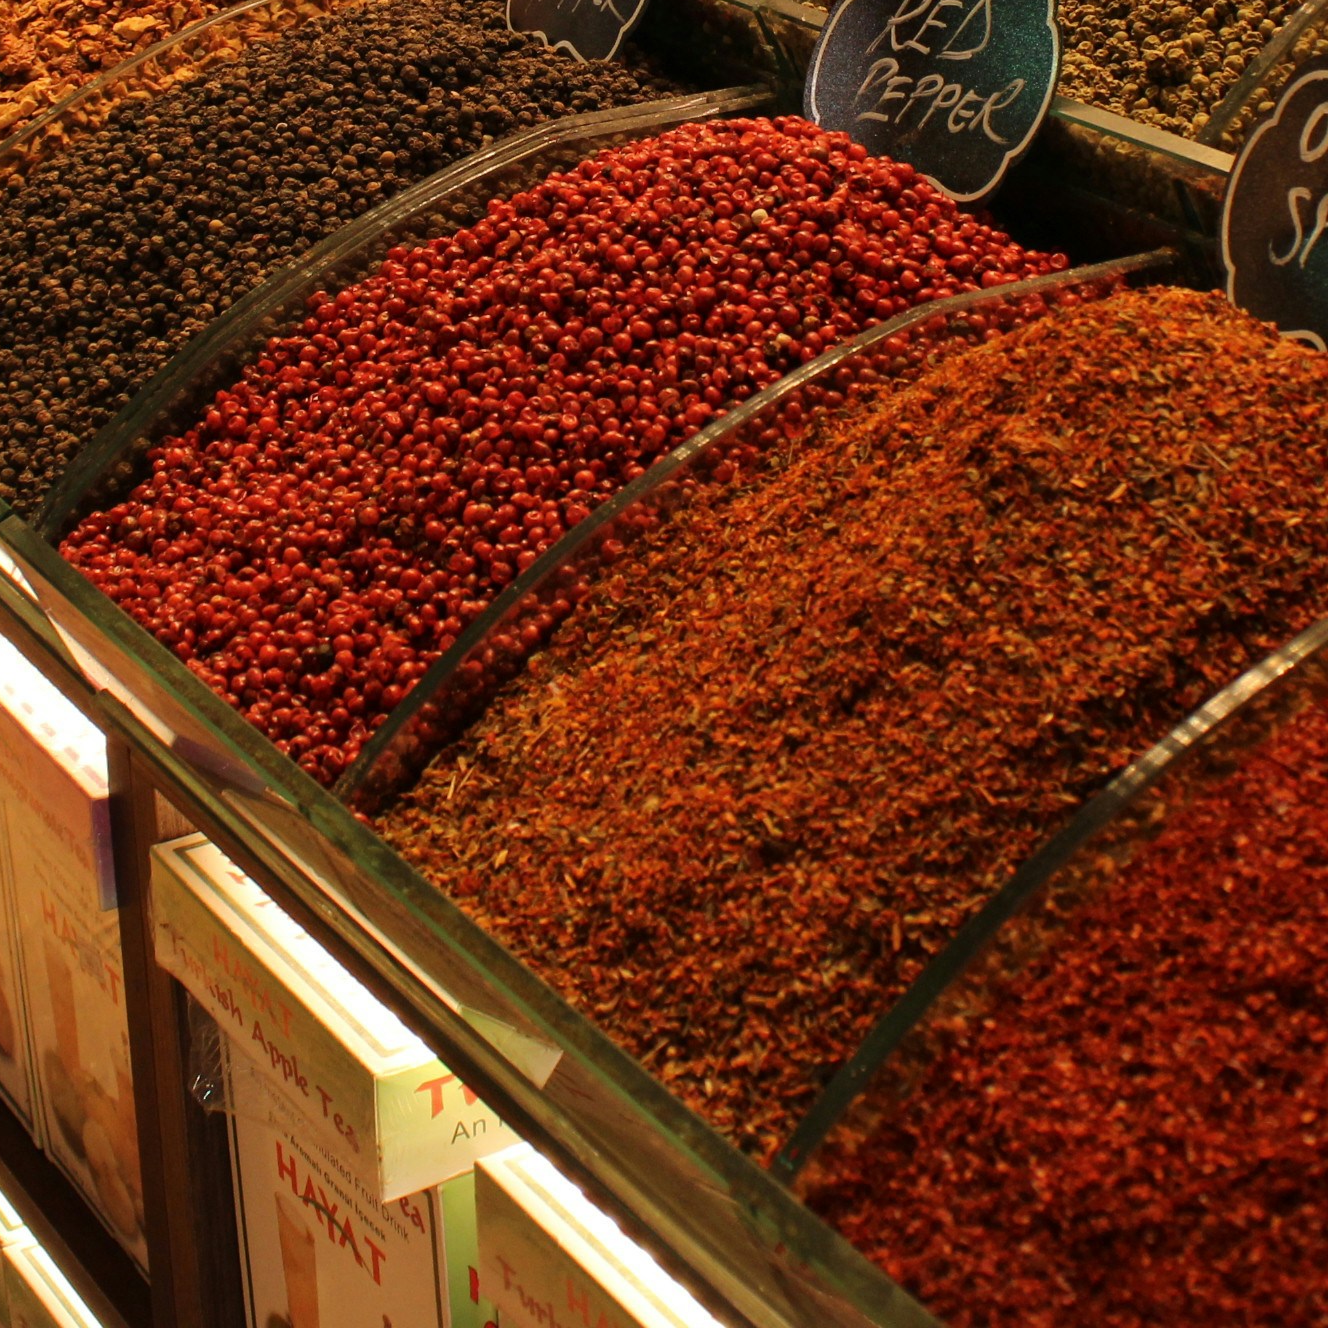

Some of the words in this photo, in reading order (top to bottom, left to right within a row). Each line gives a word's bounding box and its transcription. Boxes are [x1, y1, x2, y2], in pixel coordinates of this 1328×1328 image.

[852, 57, 1025, 145] PEPPER
[213, 934, 293, 1039] HAYAT
[251, 1020, 310, 1098] Apple
[315, 1084, 360, 1154] Tea
[275, 1139, 386, 1286] HAYAT
[381, 1204, 411, 1245] Drink
[398, 1196, 425, 1234] ea
